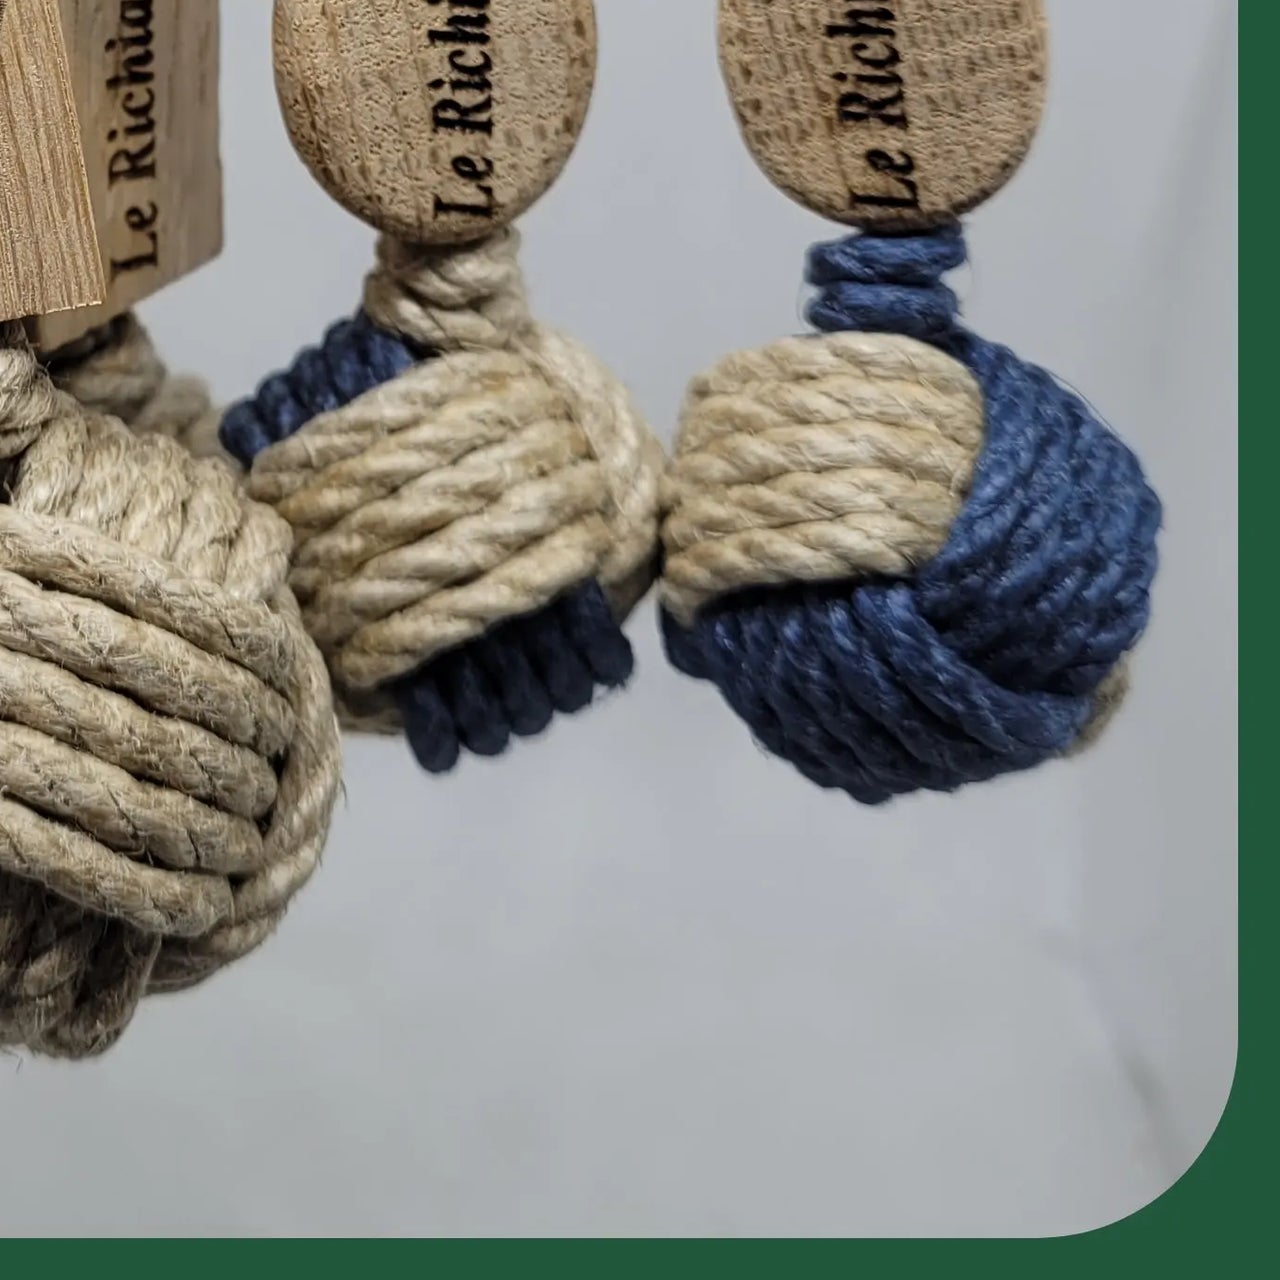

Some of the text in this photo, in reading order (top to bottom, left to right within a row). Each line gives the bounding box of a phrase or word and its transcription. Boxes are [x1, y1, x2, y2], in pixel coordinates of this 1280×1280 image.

[433, 154, 494, 222] Le
[849, 147, 920, 215] Le
[111, 205, 158, 281] Le
